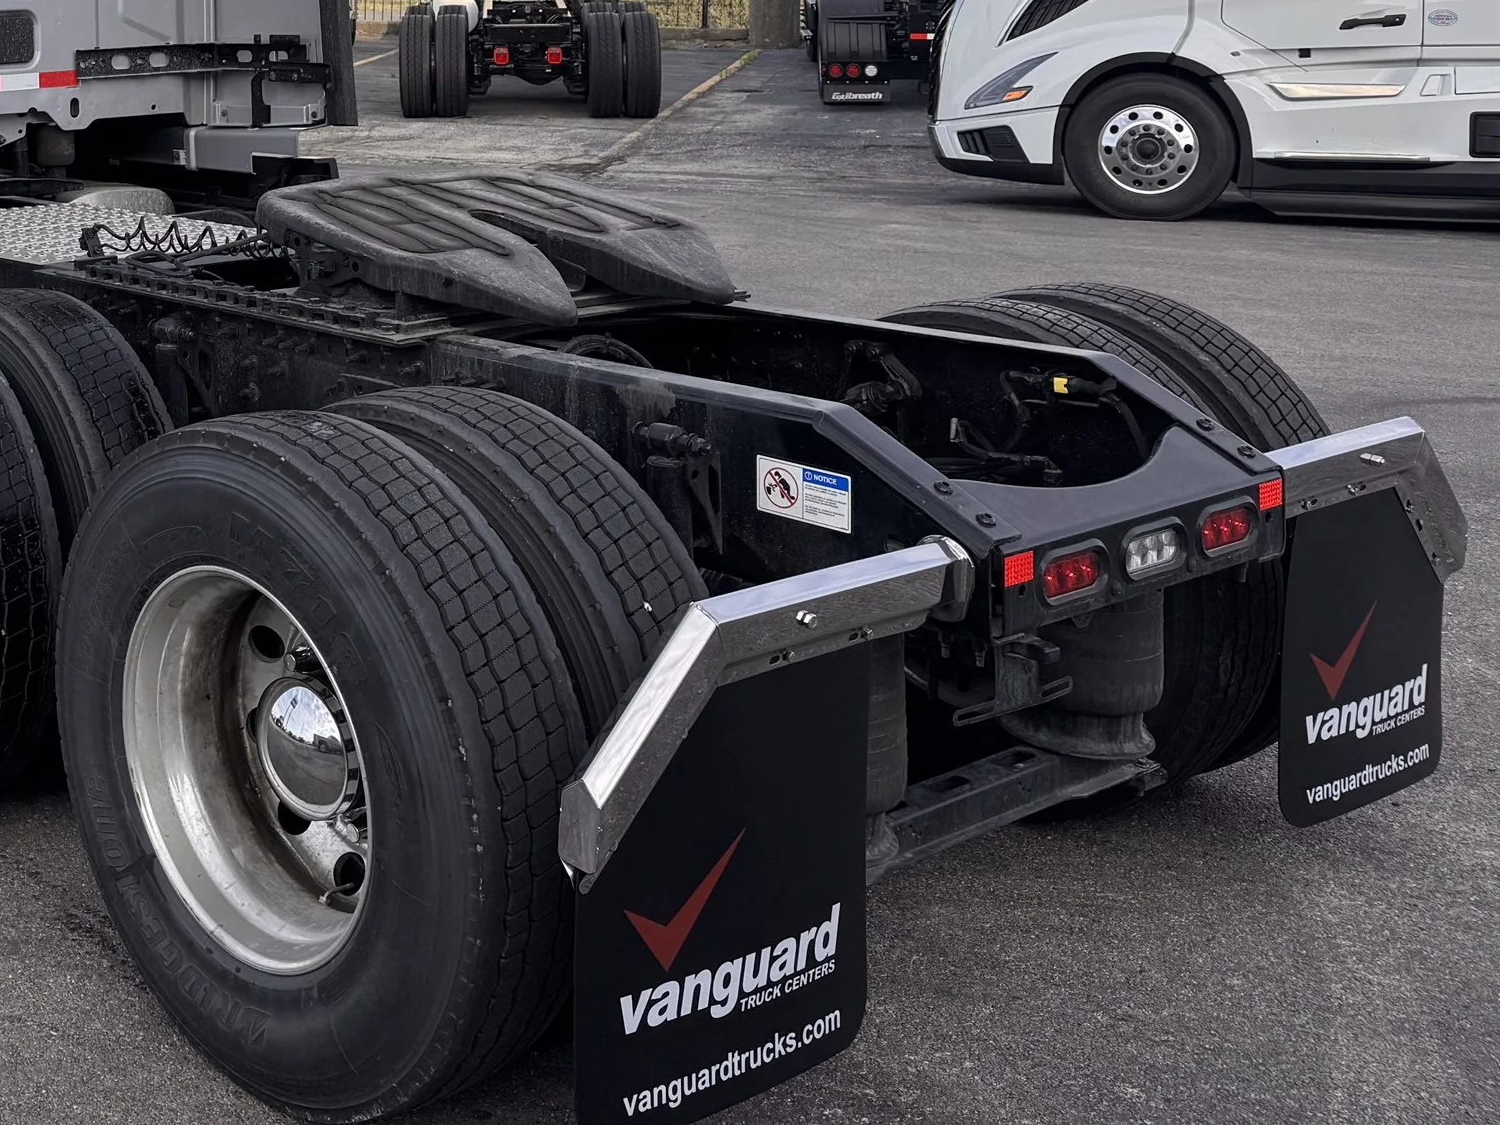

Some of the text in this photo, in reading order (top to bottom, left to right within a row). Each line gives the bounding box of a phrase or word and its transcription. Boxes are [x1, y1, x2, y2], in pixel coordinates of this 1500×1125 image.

[813, 474, 837, 485] NOTICE
[1306, 663, 1428, 744] vanguard
[1372, 705, 1425, 736] TRUCK CENTERS
[1307, 744, 1429, 803] vanguardtrucks.com
[620, 902, 841, 1035] vanguard
[740, 959, 836, 1012] TRUCK CENTERS
[623, 1010, 841, 1116] vanguardtrucks.com
